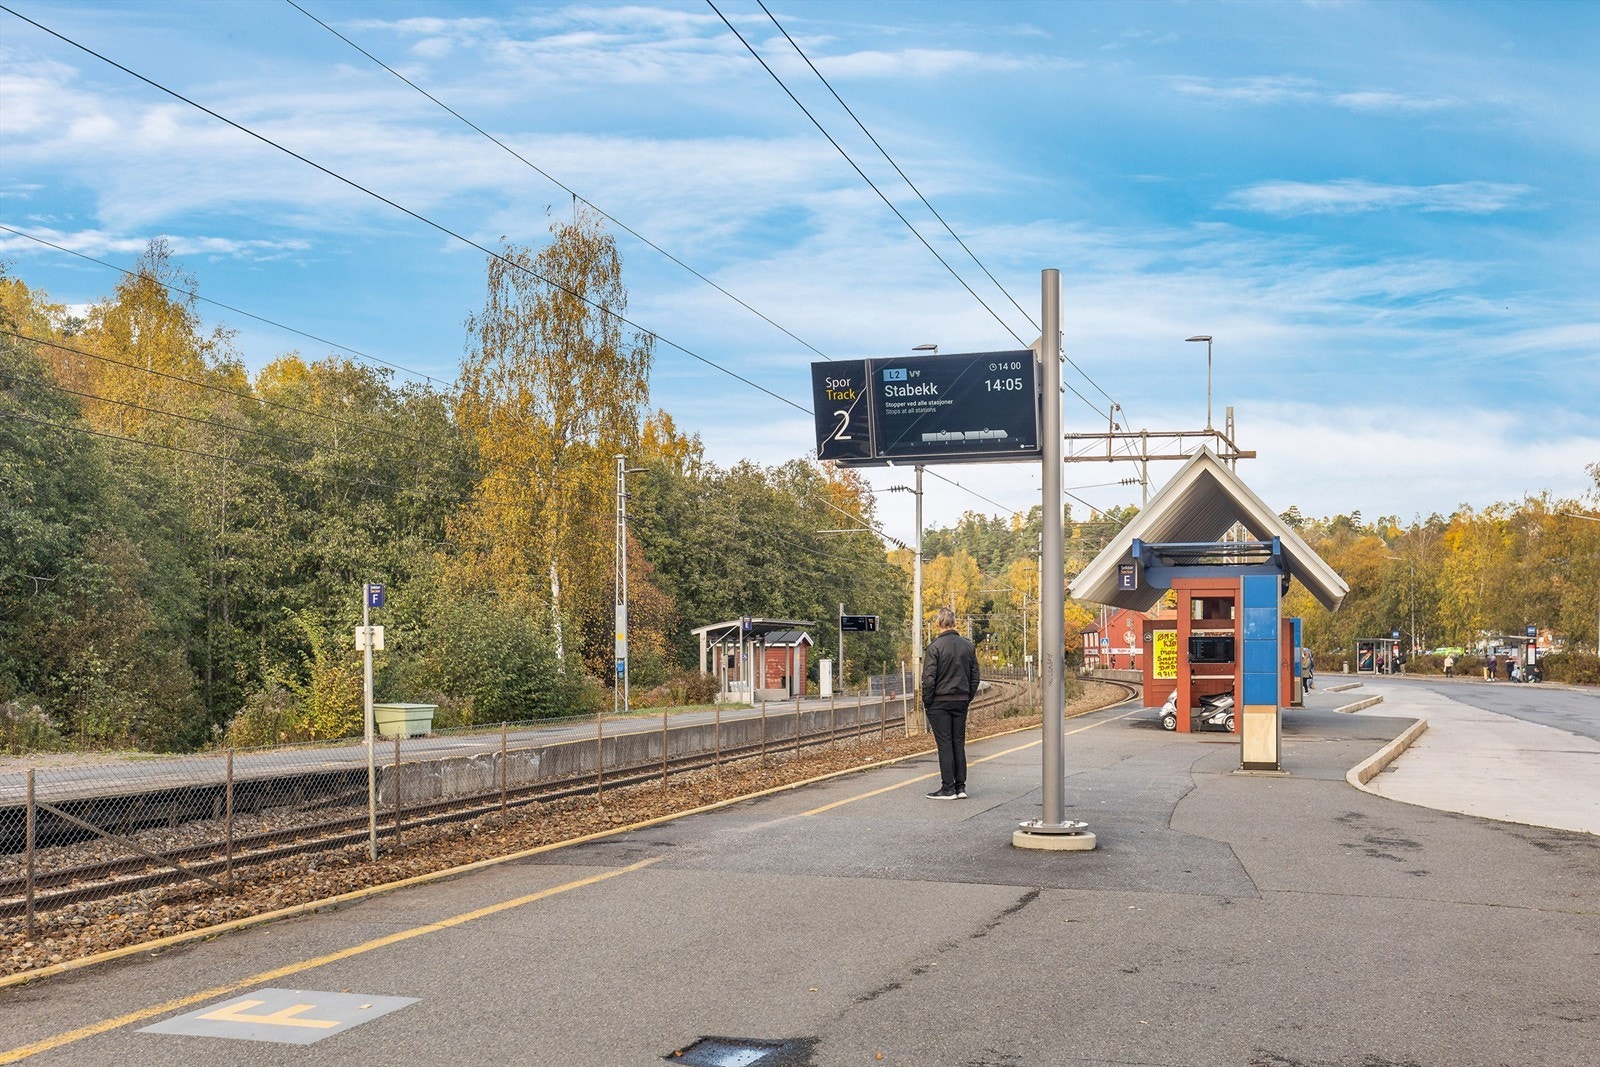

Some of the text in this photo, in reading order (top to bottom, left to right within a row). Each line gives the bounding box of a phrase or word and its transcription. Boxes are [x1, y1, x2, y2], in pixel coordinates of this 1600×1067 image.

[889, 370, 900, 379] L2
[825, 376, 851, 390] Spor
[884, 382, 939, 397] Stabekk
[984, 377, 1023, 392] 14:05
[826, 388, 856, 401] Track
[928, 399, 954, 407] stasjoner
[833, 409, 852, 441] 2
[1124, 575, 1131, 587] E
[372, 594, 378, 604] F
[195, 1000, 342, 1029] F
